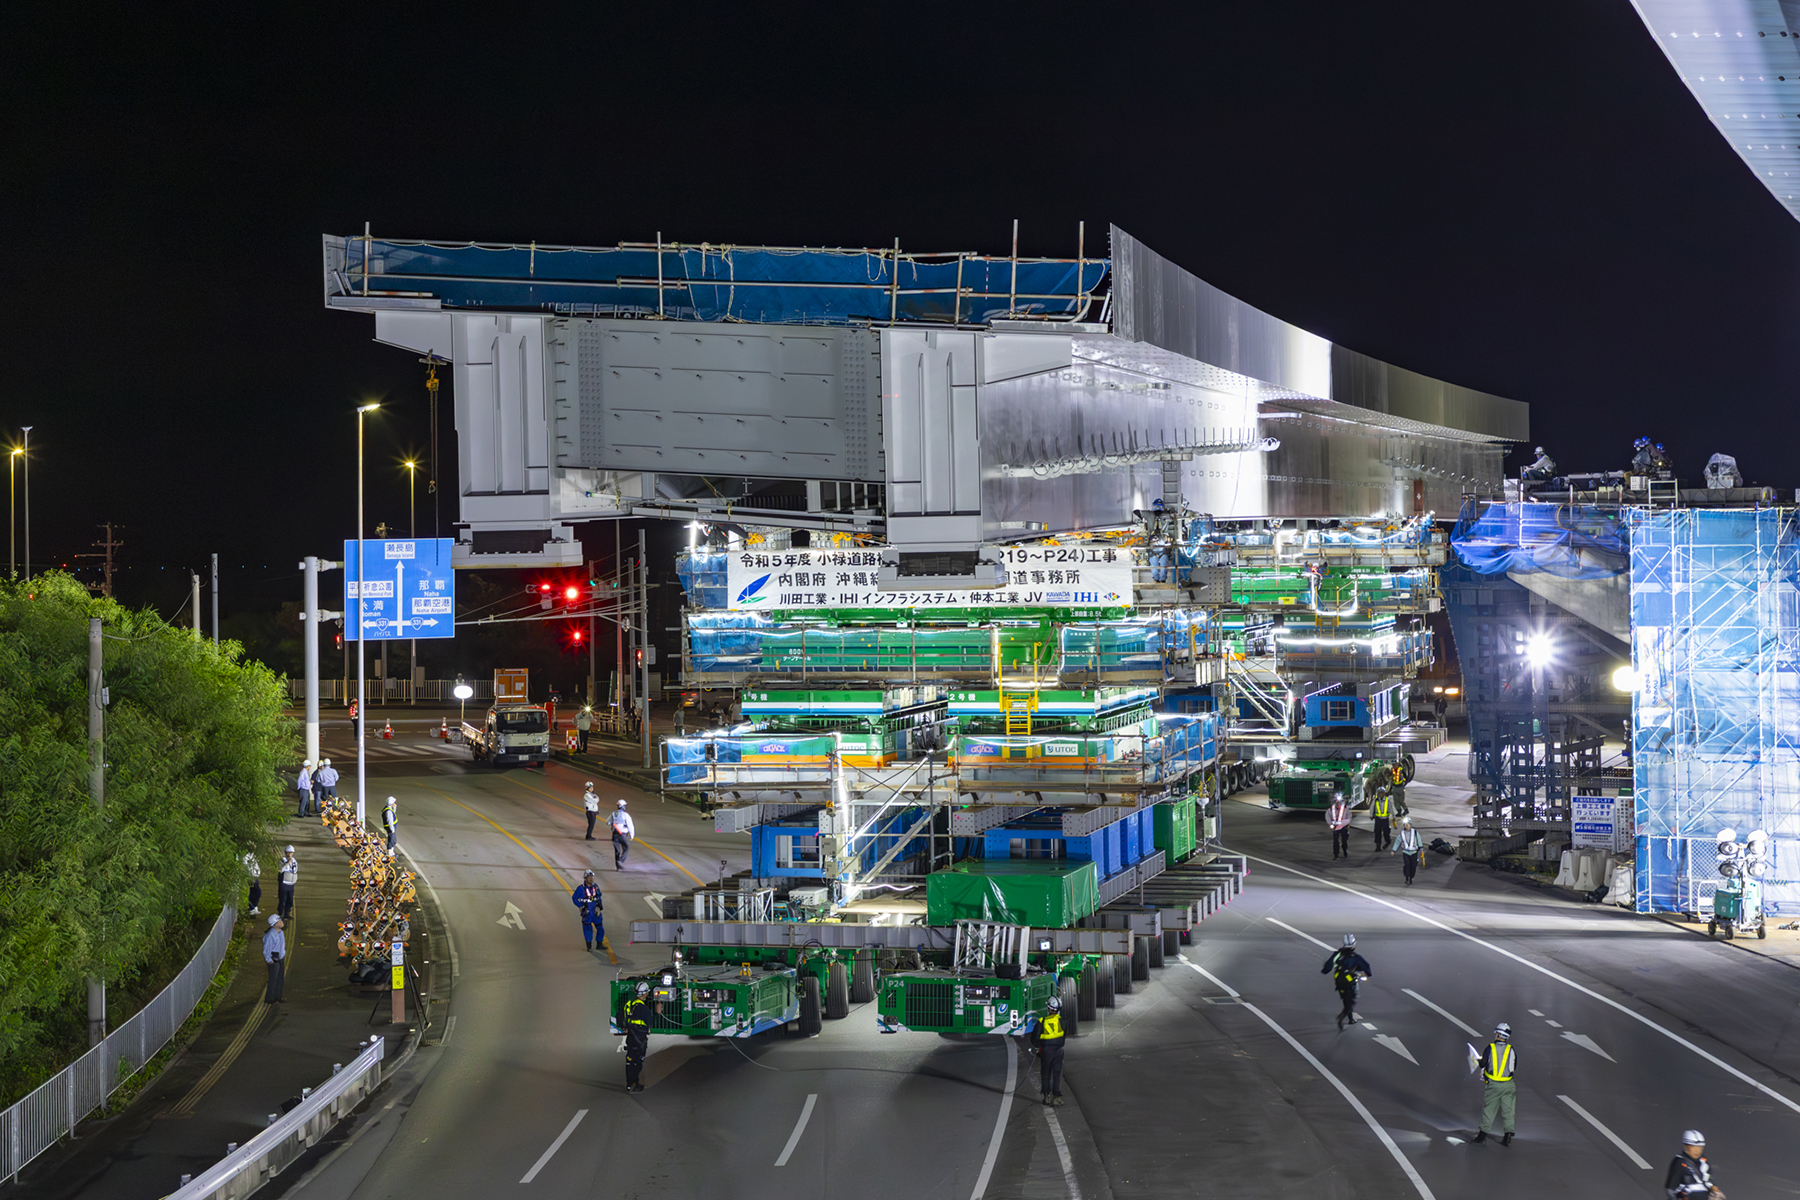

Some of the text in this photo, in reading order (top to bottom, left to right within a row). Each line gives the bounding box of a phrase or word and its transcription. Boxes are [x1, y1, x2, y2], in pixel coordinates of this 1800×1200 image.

[386, 543, 414, 552] 瀬長島
[740, 552, 811, 568] 令和5年度
[778, 572, 826, 587] 内閣府
[349, 582, 392, 592] 平祈念公園
[1024, 591, 1042, 603] JV
[1073, 592, 1099, 602] IHI
[414, 599, 450, 607] 那覇空港
[949, 693, 976, 701] 2号機
[888, 980, 905, 988] P24
